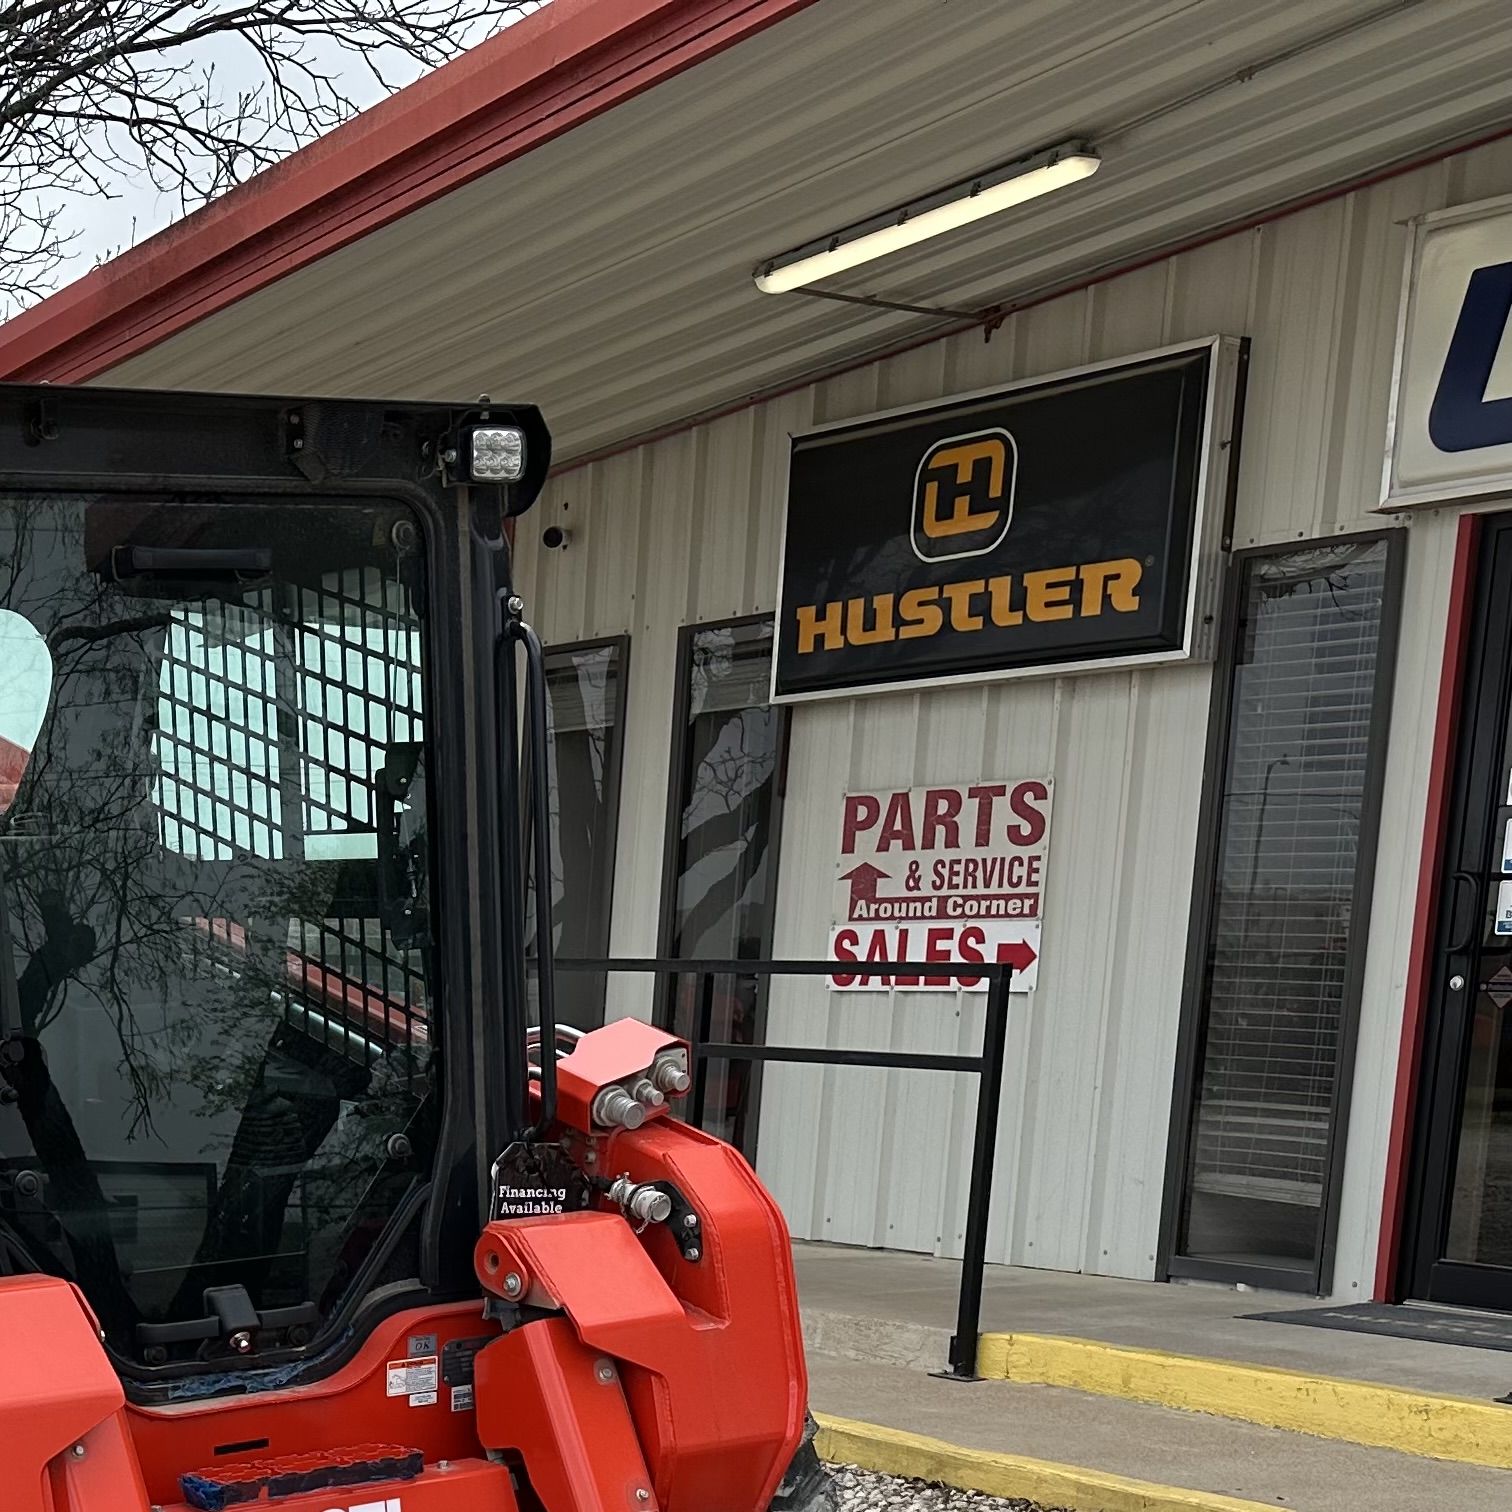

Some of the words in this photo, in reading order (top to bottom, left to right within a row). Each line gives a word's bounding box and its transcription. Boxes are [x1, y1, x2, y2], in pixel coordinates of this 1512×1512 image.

[796, 558, 1143, 654] HUSTLER
[841, 781, 1048, 854] PARTS
[905, 860, 921, 892] &
[931, 855, 1042, 891] SERVICE
[852, 897, 937, 918] Around
[946, 895, 1034, 917] Corner
[831, 926, 986, 987] SALES
[501, 1201, 563, 1214] Available
